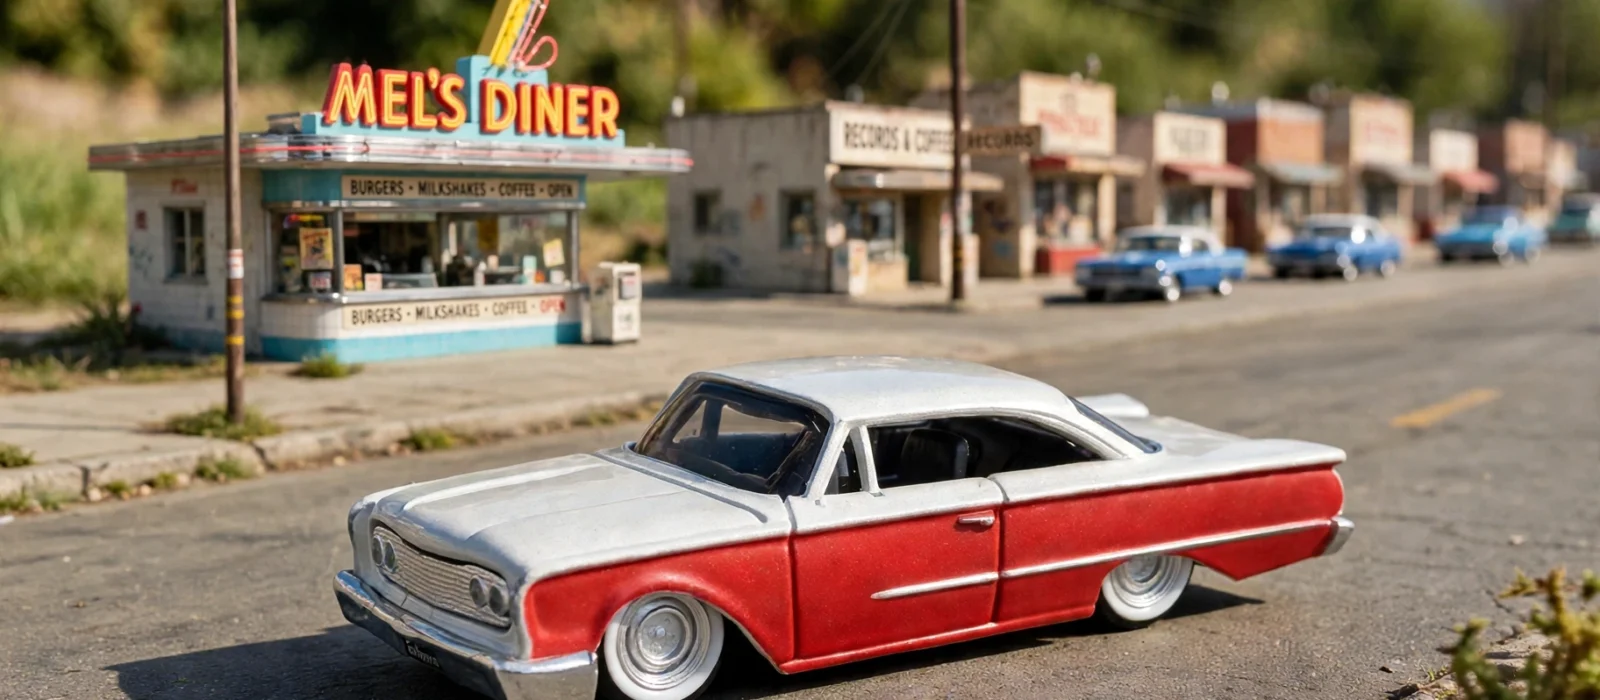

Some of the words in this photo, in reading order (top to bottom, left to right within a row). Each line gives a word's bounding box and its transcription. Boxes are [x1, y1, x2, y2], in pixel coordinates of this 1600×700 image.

[321, 63, 467, 131] MEL'S
[480, 79, 620, 139] DINER
[844, 122, 899, 152] RECORDS
[350, 180, 404, 196] BURGERS
[418, 181, 486, 197] MILKSHAKES
[499, 183, 535, 197] COFFEE
[547, 183, 573, 198] OPEN
[351, 307, 403, 325] BURGERS
[416, 304, 480, 321] MILKSHAKES
[493, 301, 528, 316] COFFEE
